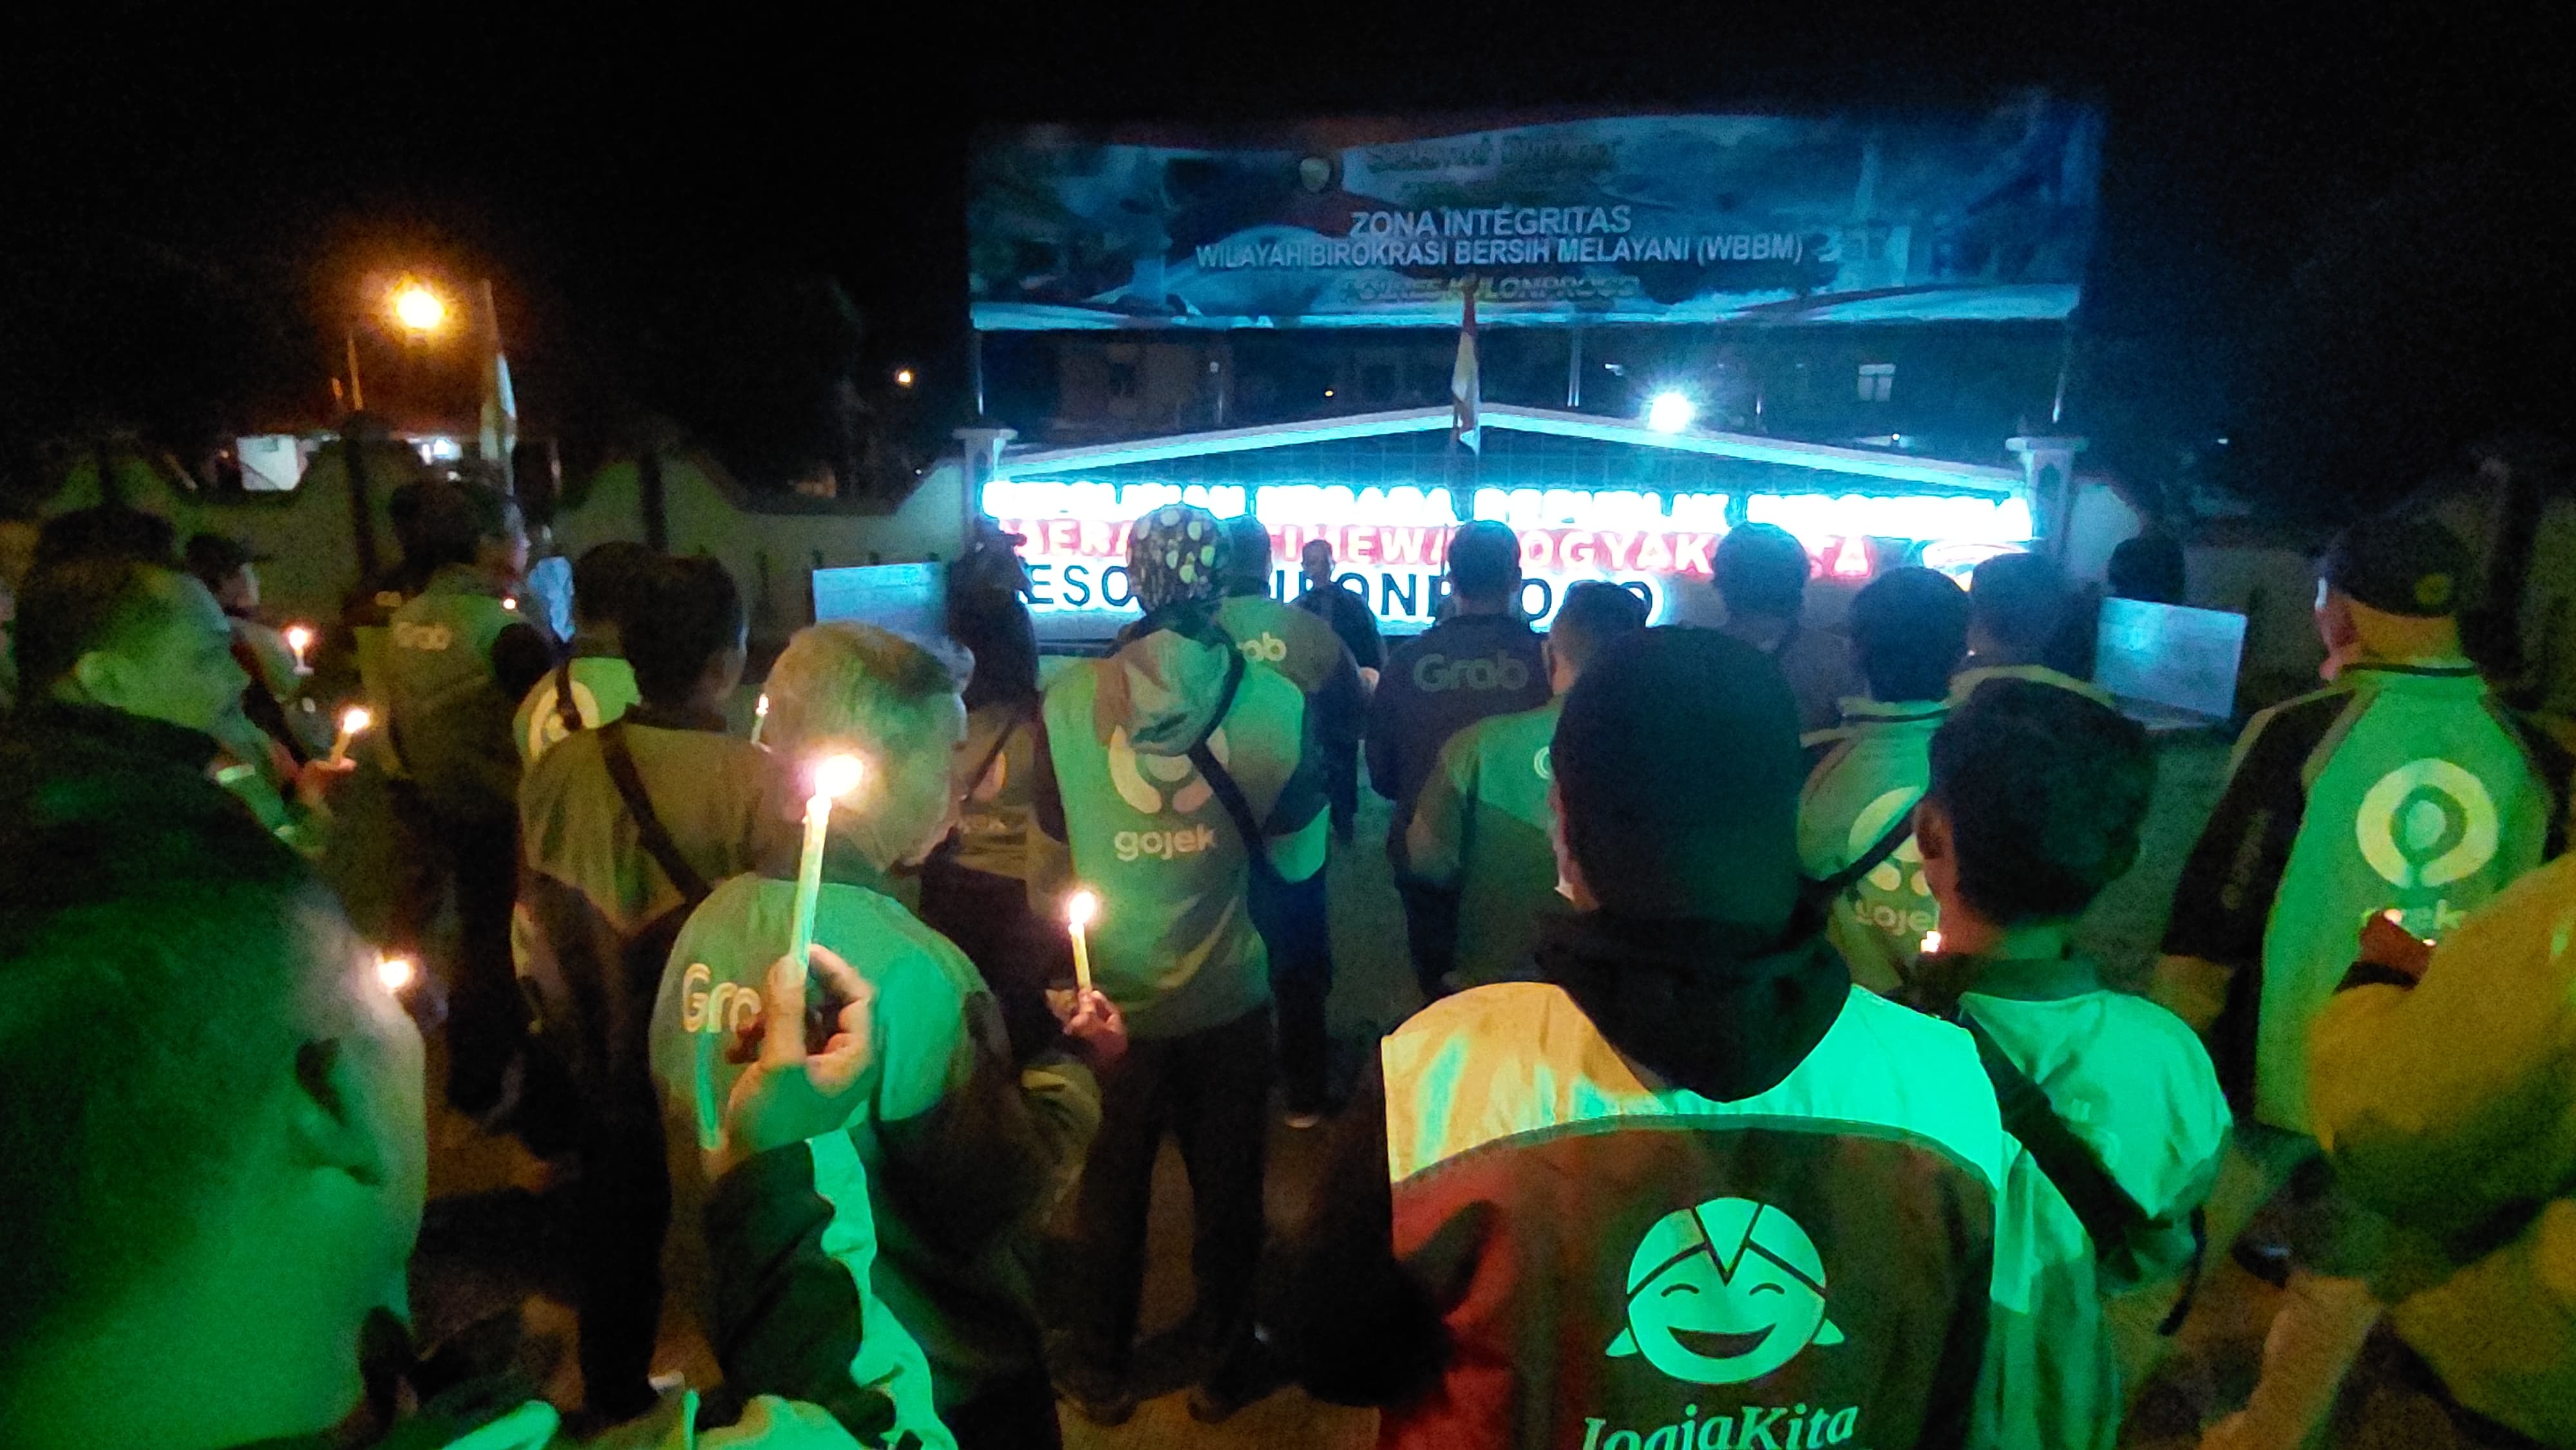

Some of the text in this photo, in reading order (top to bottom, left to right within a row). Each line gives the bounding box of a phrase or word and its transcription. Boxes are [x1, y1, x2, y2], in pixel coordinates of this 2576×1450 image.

[1350, 205, 1632, 238] ZONA INTEGRITAS
[1195, 233, 1803, 268] WILAYAH BIROKRASI BERSIH MELAYANI (WBBM)
[1238, 632, 1287, 663] ab
[1416, 648, 1529, 692] Grab
[1113, 824, 1217, 862] gojek
[682, 963, 762, 1033] Gra
